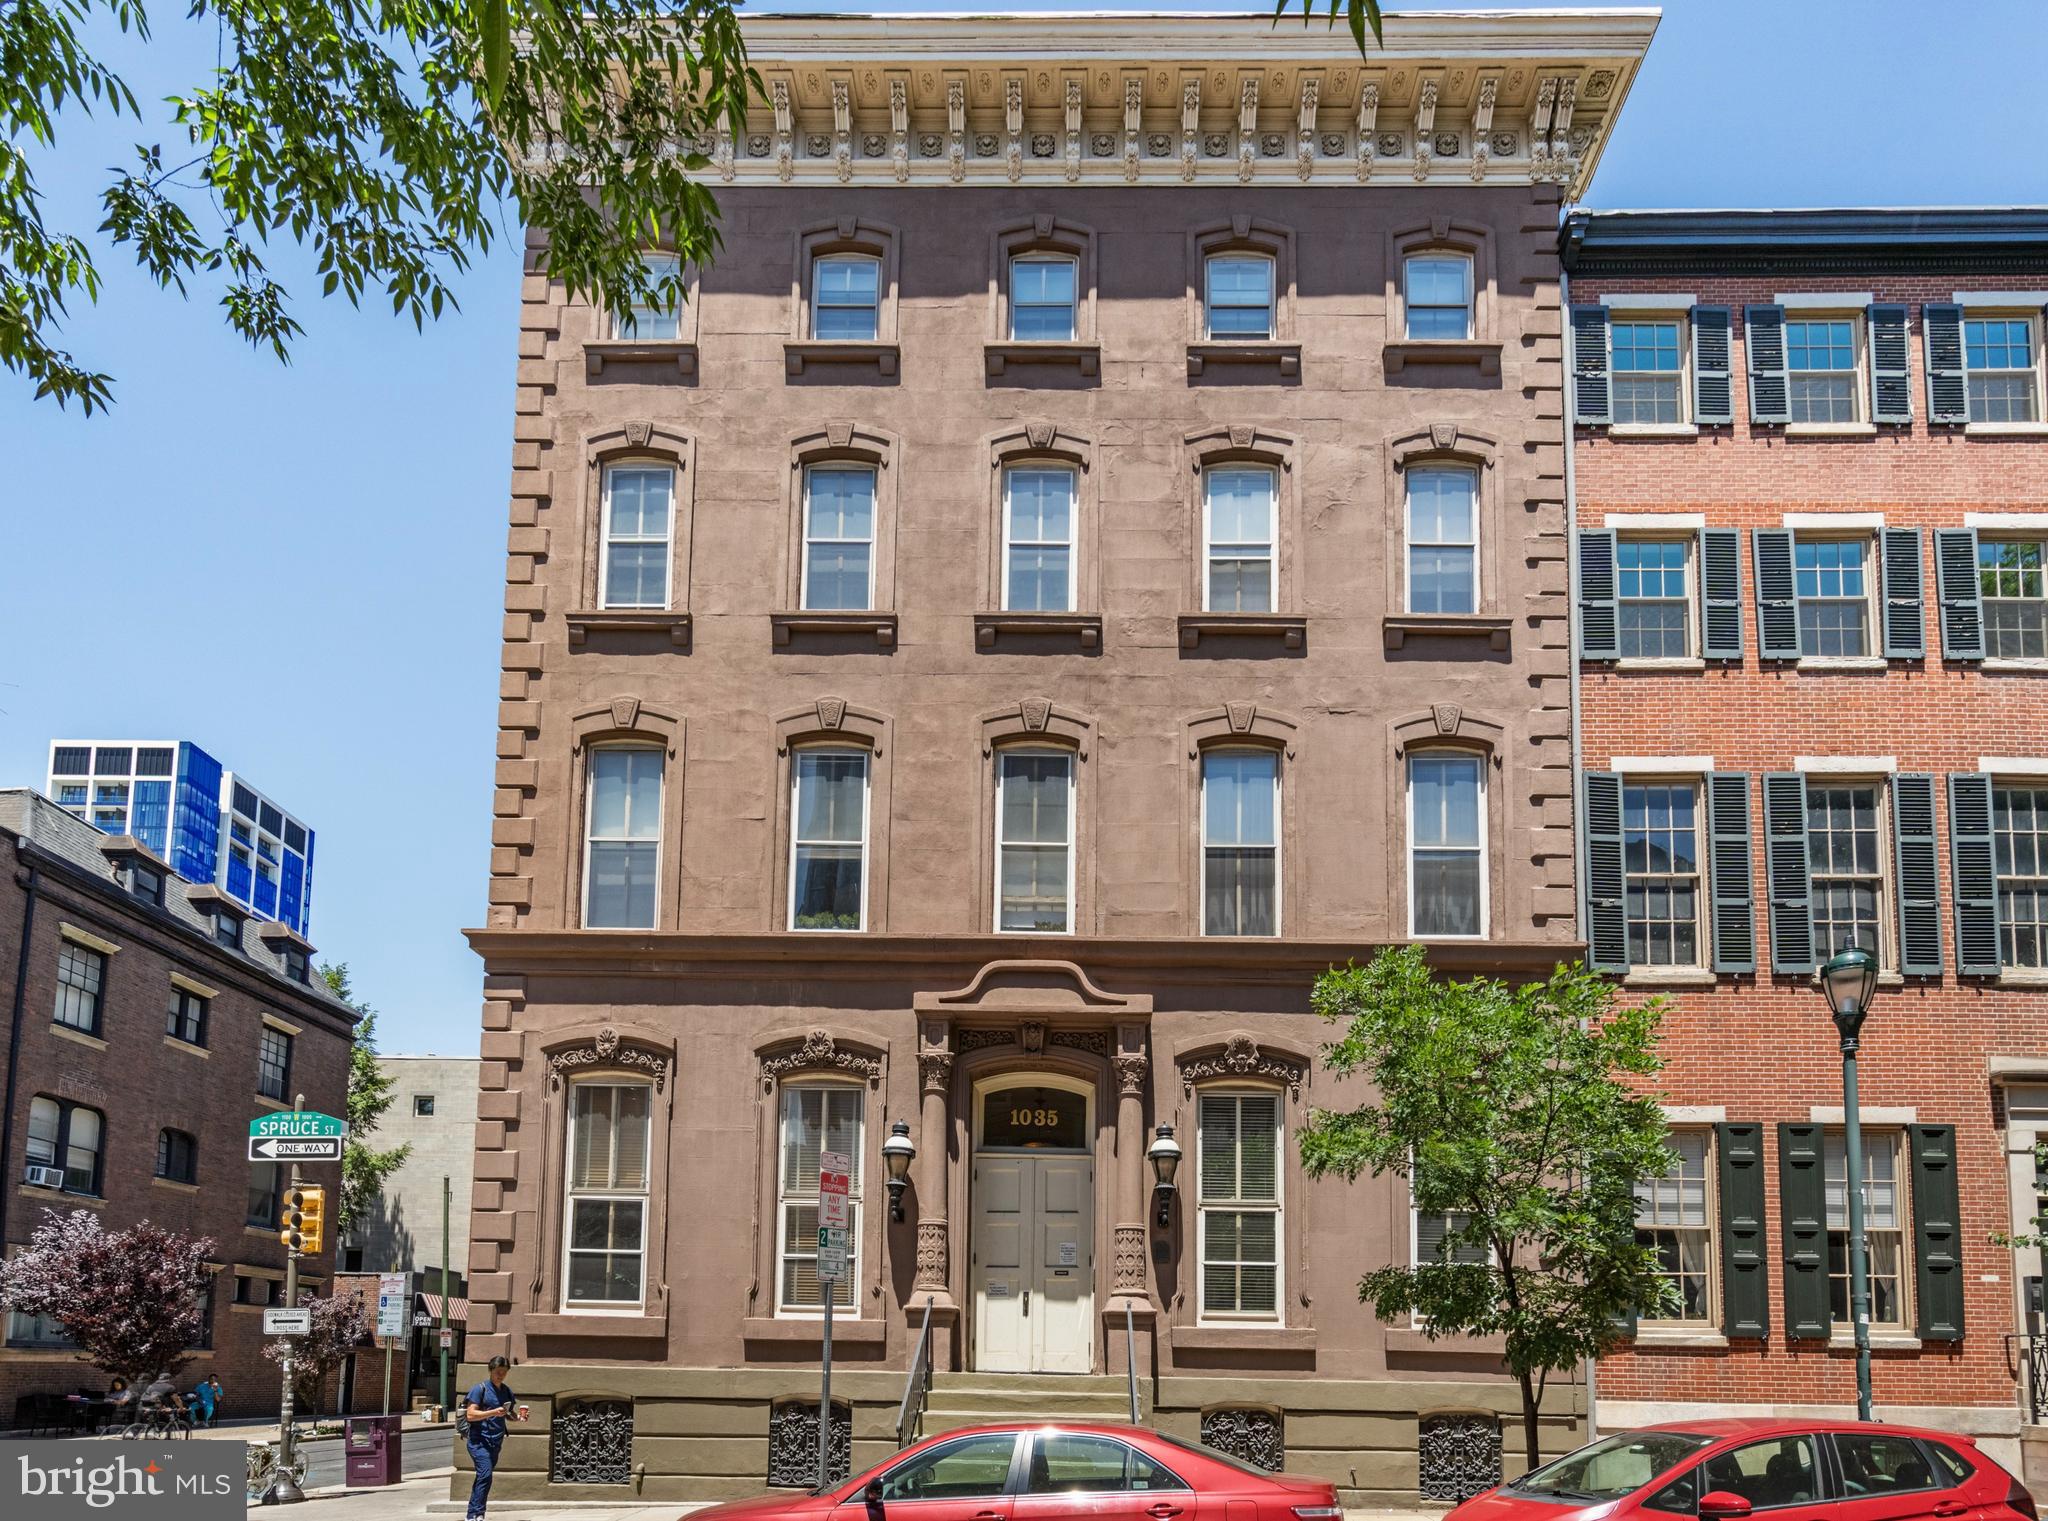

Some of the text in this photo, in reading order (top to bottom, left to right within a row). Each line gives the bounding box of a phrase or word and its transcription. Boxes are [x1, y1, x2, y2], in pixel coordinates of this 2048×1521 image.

[1010, 1108, 1058, 1126] 1035
[259, 1121, 335, 1135] SPRUCE ST
[276, 1144, 329, 1153] ONE WAY
[822, 1182, 847, 1193] STOPPING
[827, 1194, 841, 1205] ANY
[827, 1204, 841, 1215] TIME
[820, 1231, 826, 1245] 2
[828, 1239, 846, 1247] PARKING
